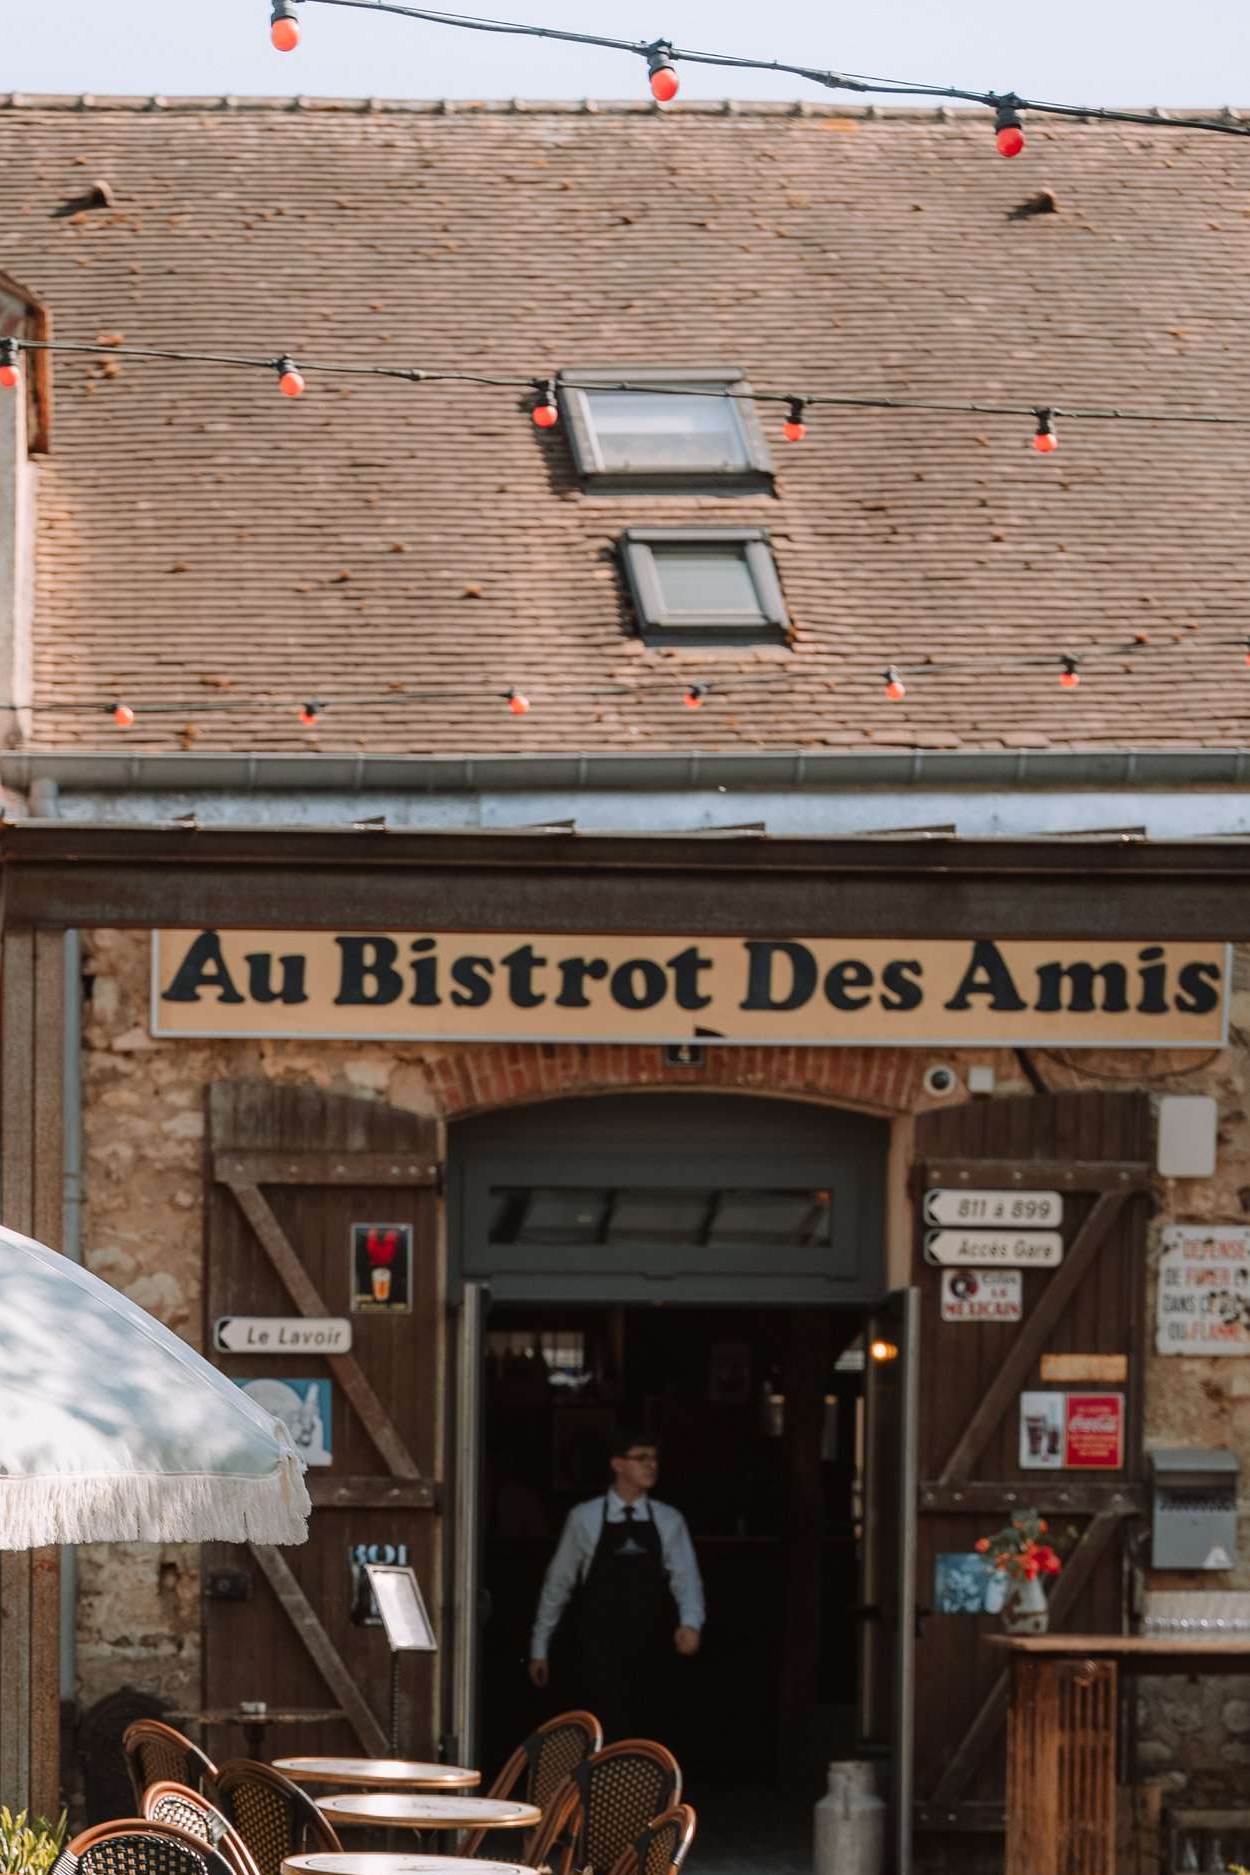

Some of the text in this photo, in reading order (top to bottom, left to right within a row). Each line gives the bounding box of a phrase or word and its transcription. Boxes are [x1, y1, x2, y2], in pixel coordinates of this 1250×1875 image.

[161, 929, 1221, 1015] Au Bistrot Des Amis
[678, 1043, 692, 1064] 4
[957, 1199, 988, 1218] 811
[1012, 1199, 1051, 1219] 899
[957, 1239, 1053, 1258] Accès Gare
[247, 1326, 343, 1345] Le Lavoir
